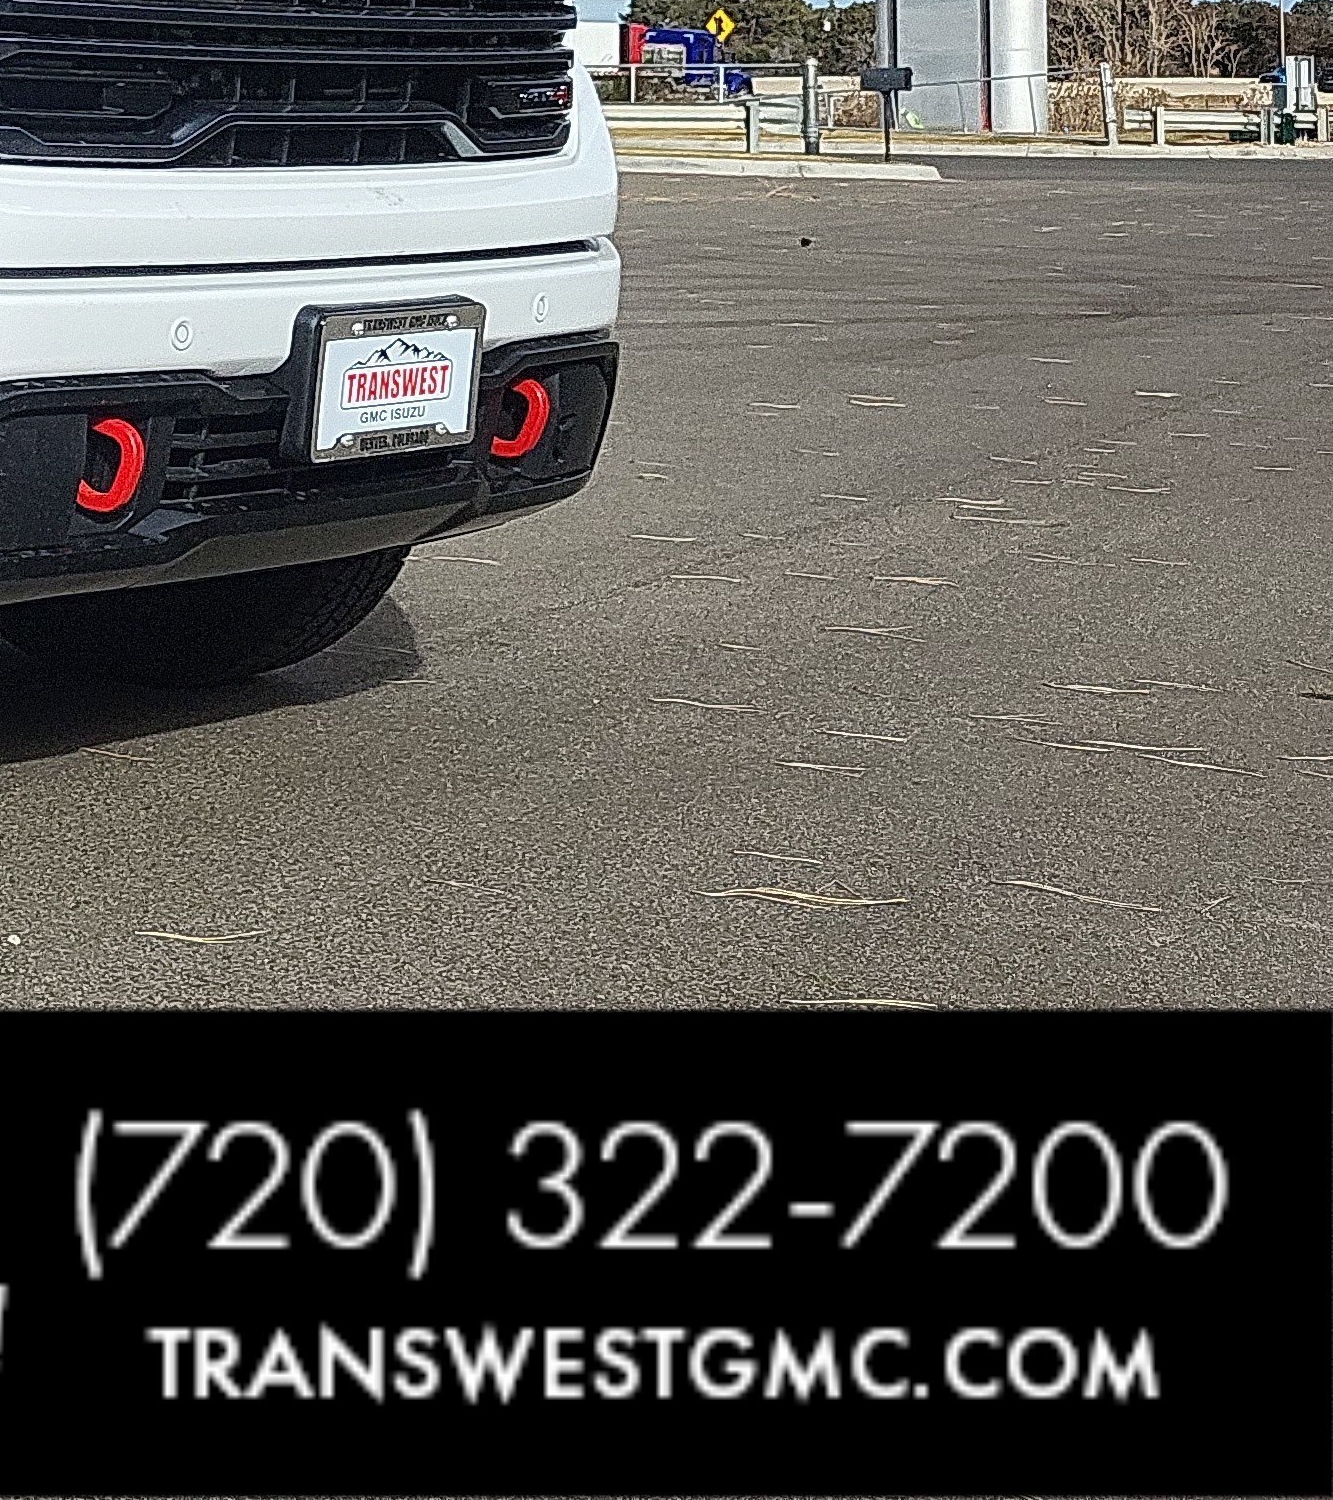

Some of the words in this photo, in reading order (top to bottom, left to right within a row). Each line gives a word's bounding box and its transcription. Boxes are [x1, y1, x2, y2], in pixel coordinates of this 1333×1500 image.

[346, 364, 451, 404] TRANSWEST
[359, 410, 388, 424] GMC
[390, 405, 427, 421] ISUZU
